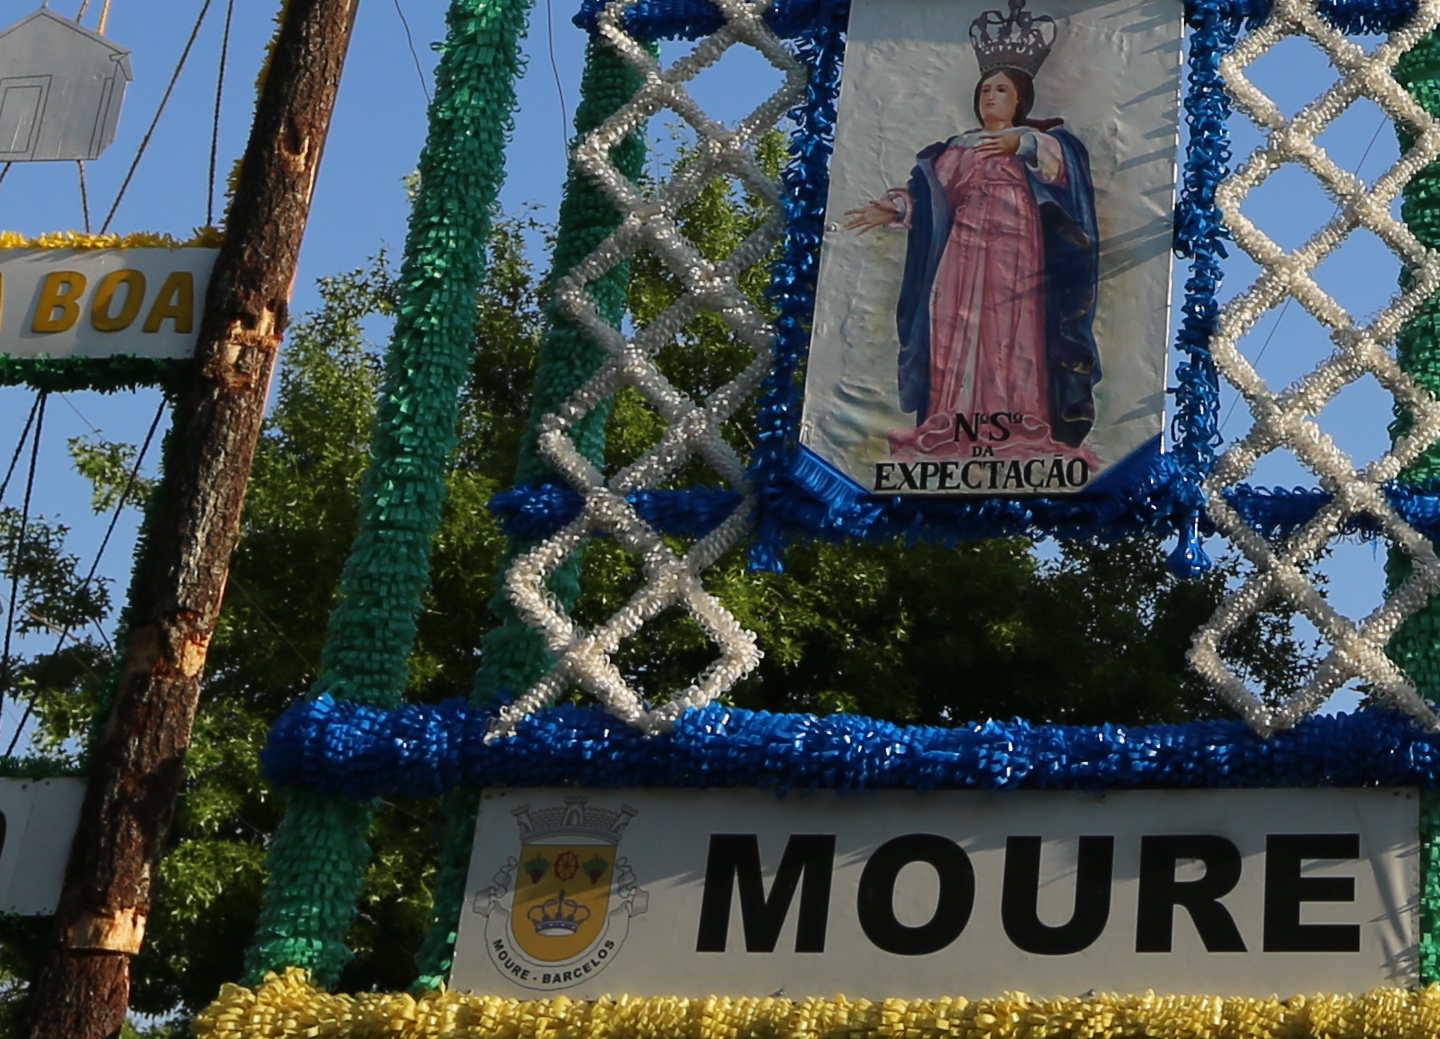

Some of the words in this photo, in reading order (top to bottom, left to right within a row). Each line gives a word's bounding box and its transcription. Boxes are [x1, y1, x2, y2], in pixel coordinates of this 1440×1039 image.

[30, 269, 194, 334] BOA
[874, 454, 1089, 492] EXPECTAÇÃO
[971, 445, 994, 458] DA
[696, 833, 1360, 955] MOURE
[492, 938, 531, 981] MOURE
[542, 939, 615, 984] BARCELOS
